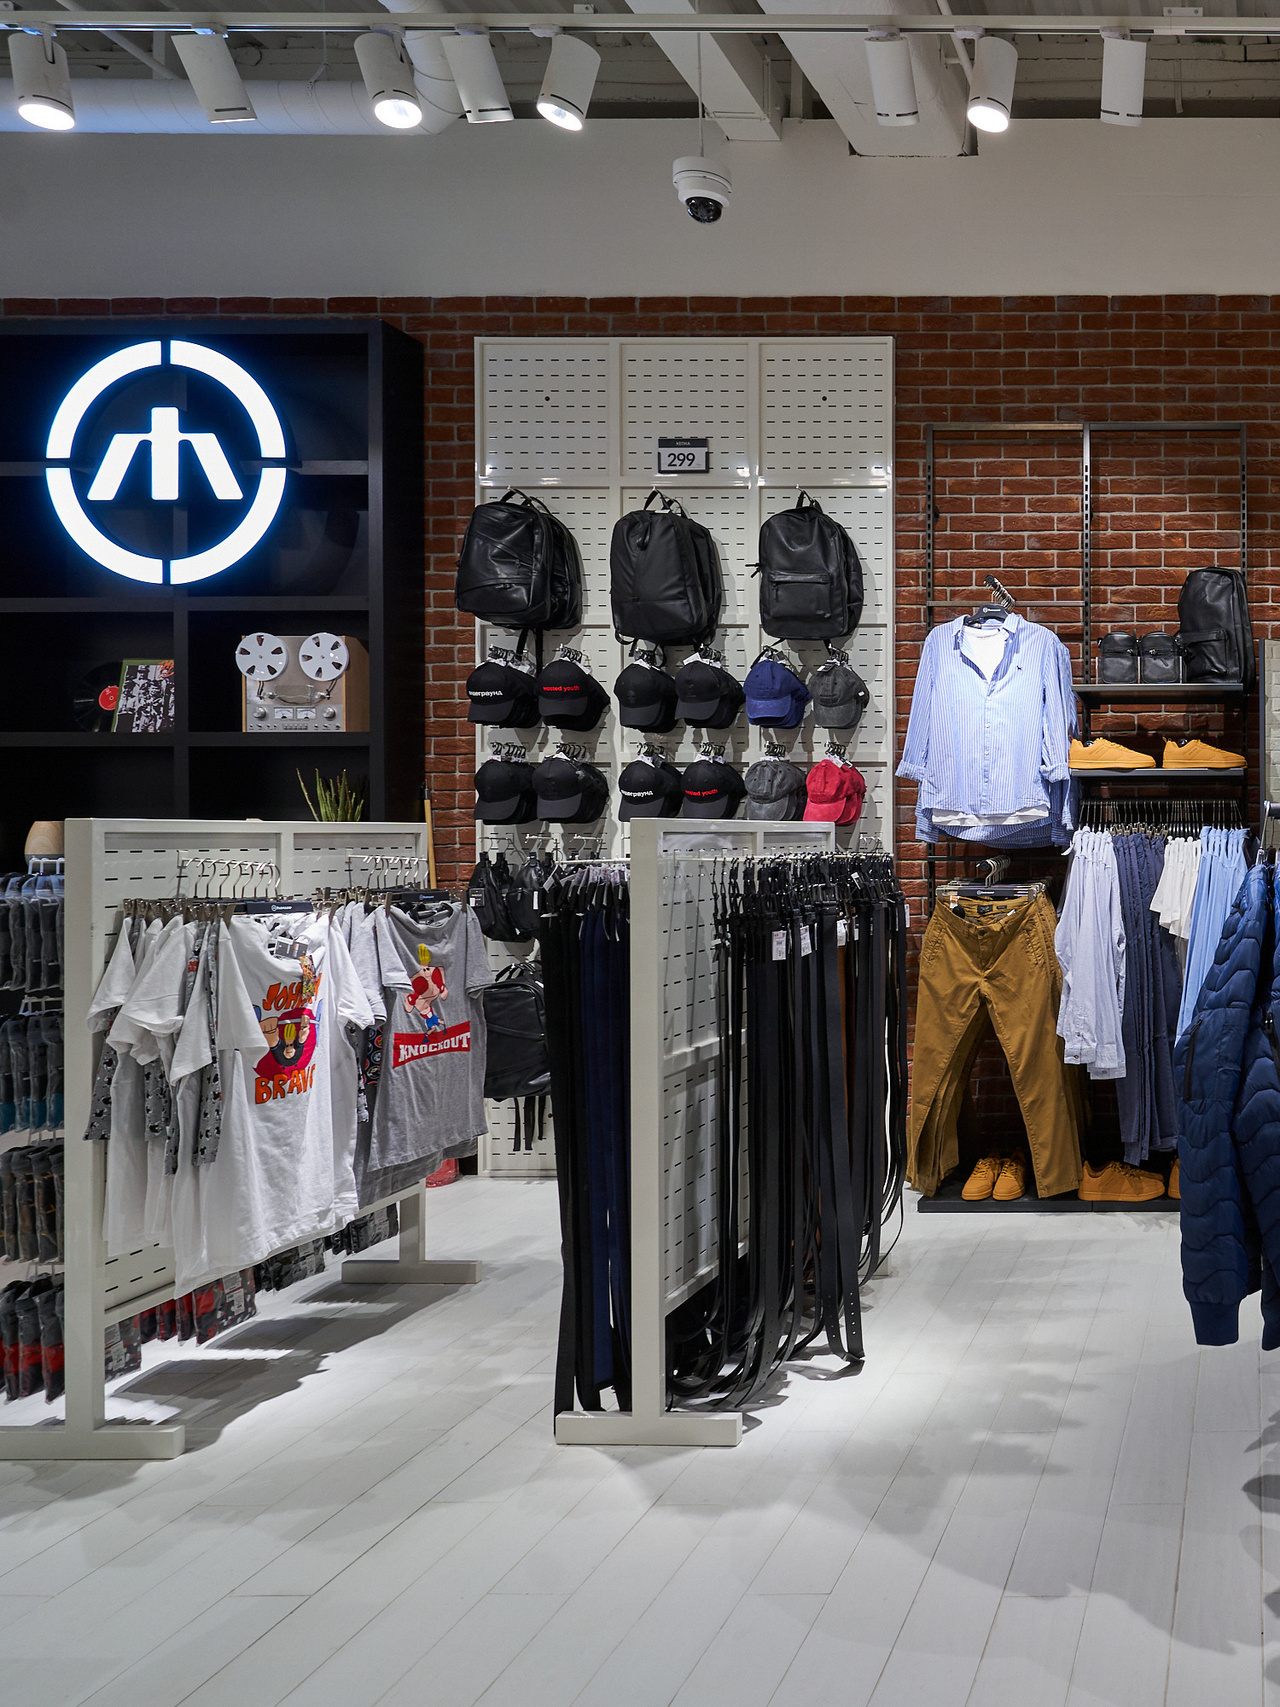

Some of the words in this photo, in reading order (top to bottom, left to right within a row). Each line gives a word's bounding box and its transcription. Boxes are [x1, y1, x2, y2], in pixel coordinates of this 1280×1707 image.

[667, 452, 696, 467] 299
[262, 972, 322, 1011] JOHY
[398, 1031, 471, 1063] KNOCKOUT
